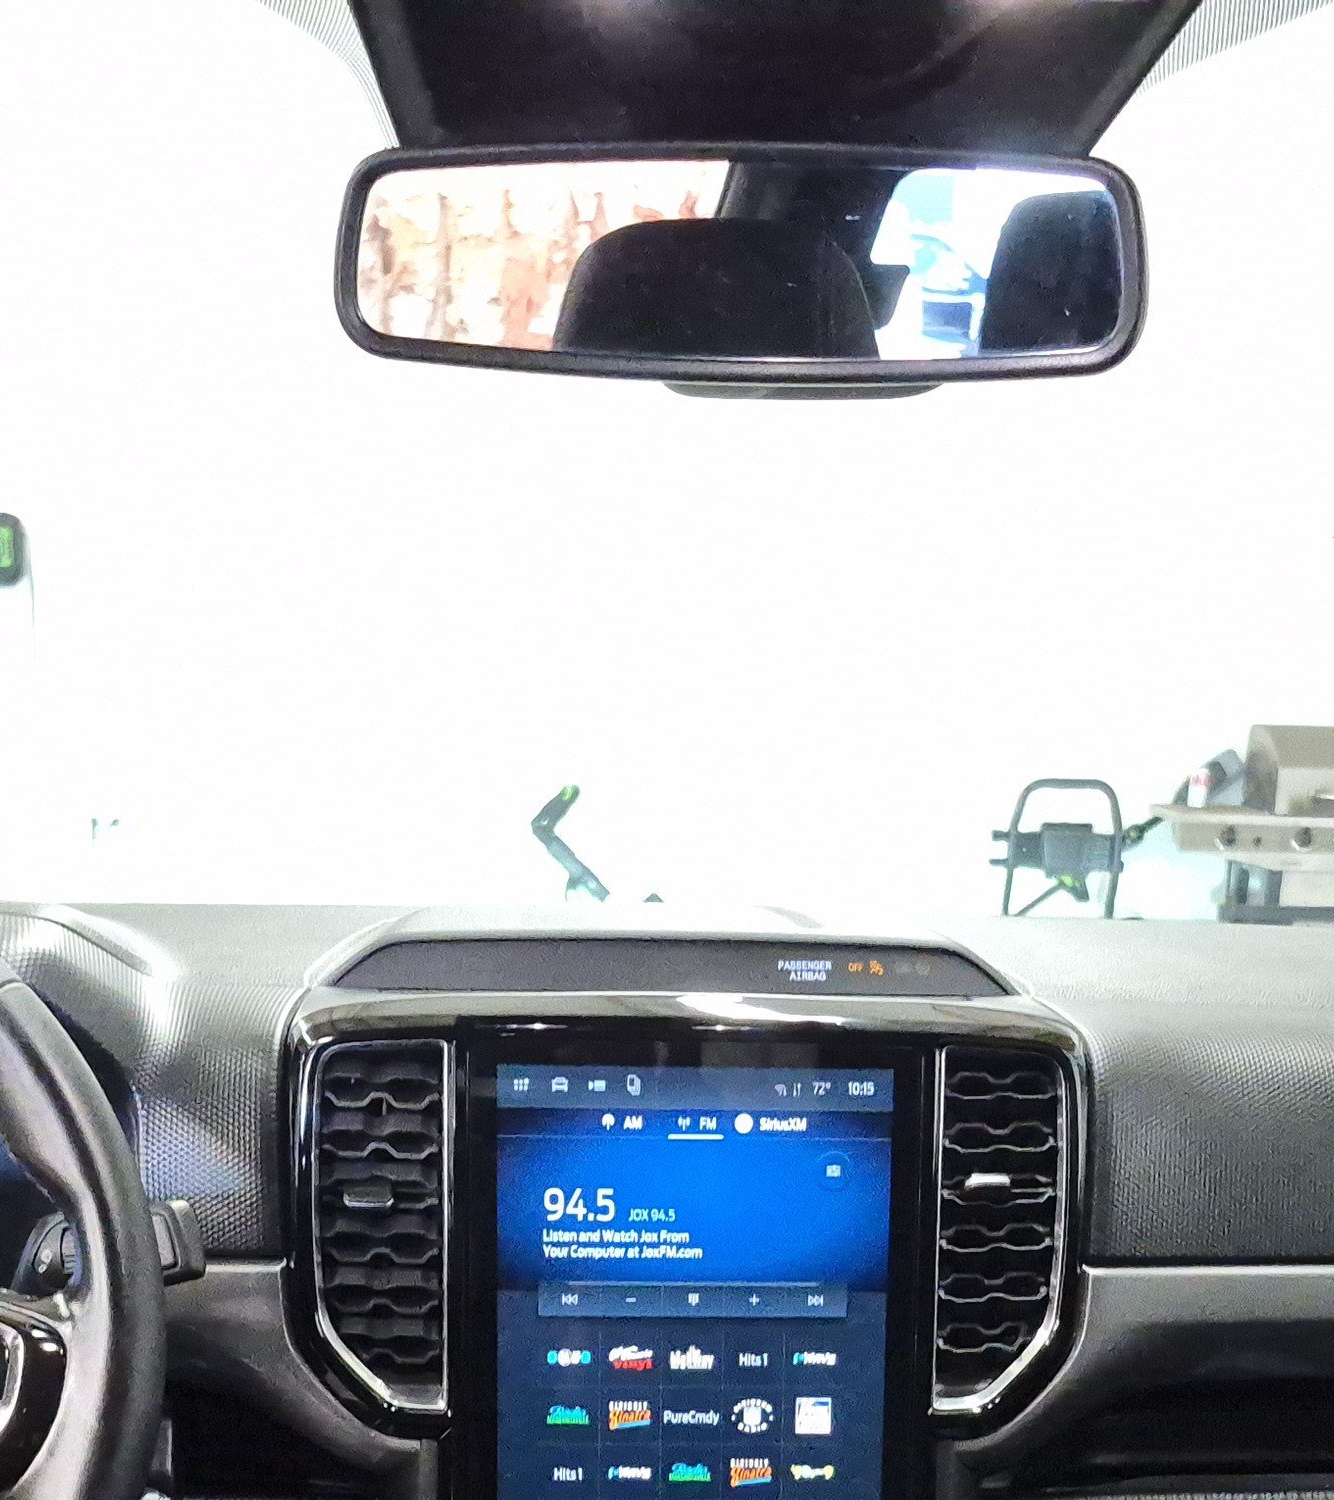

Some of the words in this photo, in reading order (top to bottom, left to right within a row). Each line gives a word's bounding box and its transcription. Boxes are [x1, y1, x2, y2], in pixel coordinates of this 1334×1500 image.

[777, 960, 832, 971] PASSENGER
[848, 962, 864, 972] OFF
[789, 970, 827, 981] AIRBAG
[847, 1081, 875, 1096] 10:15
[623, 1115, 643, 1130] AM
[699, 1117, 717, 1131] FM
[759, 1117, 807, 1132] SiriusXM
[543, 1187, 616, 1222] 94.5
[628, 1208, 649, 1222] JOX
[650, 1208, 676, 1222] 94.5
[542, 1228, 578, 1243] Listen
[578, 1229, 601, 1243] and
[602, 1229, 639, 1243] Watch
[660, 1230, 690, 1243] From
[543, 1244, 569, 1259] Your
[570, 1245, 626, 1260] Computer
[627, 1245, 640, 1259] at
[663, 1409, 720, 1426] PureCmdy
